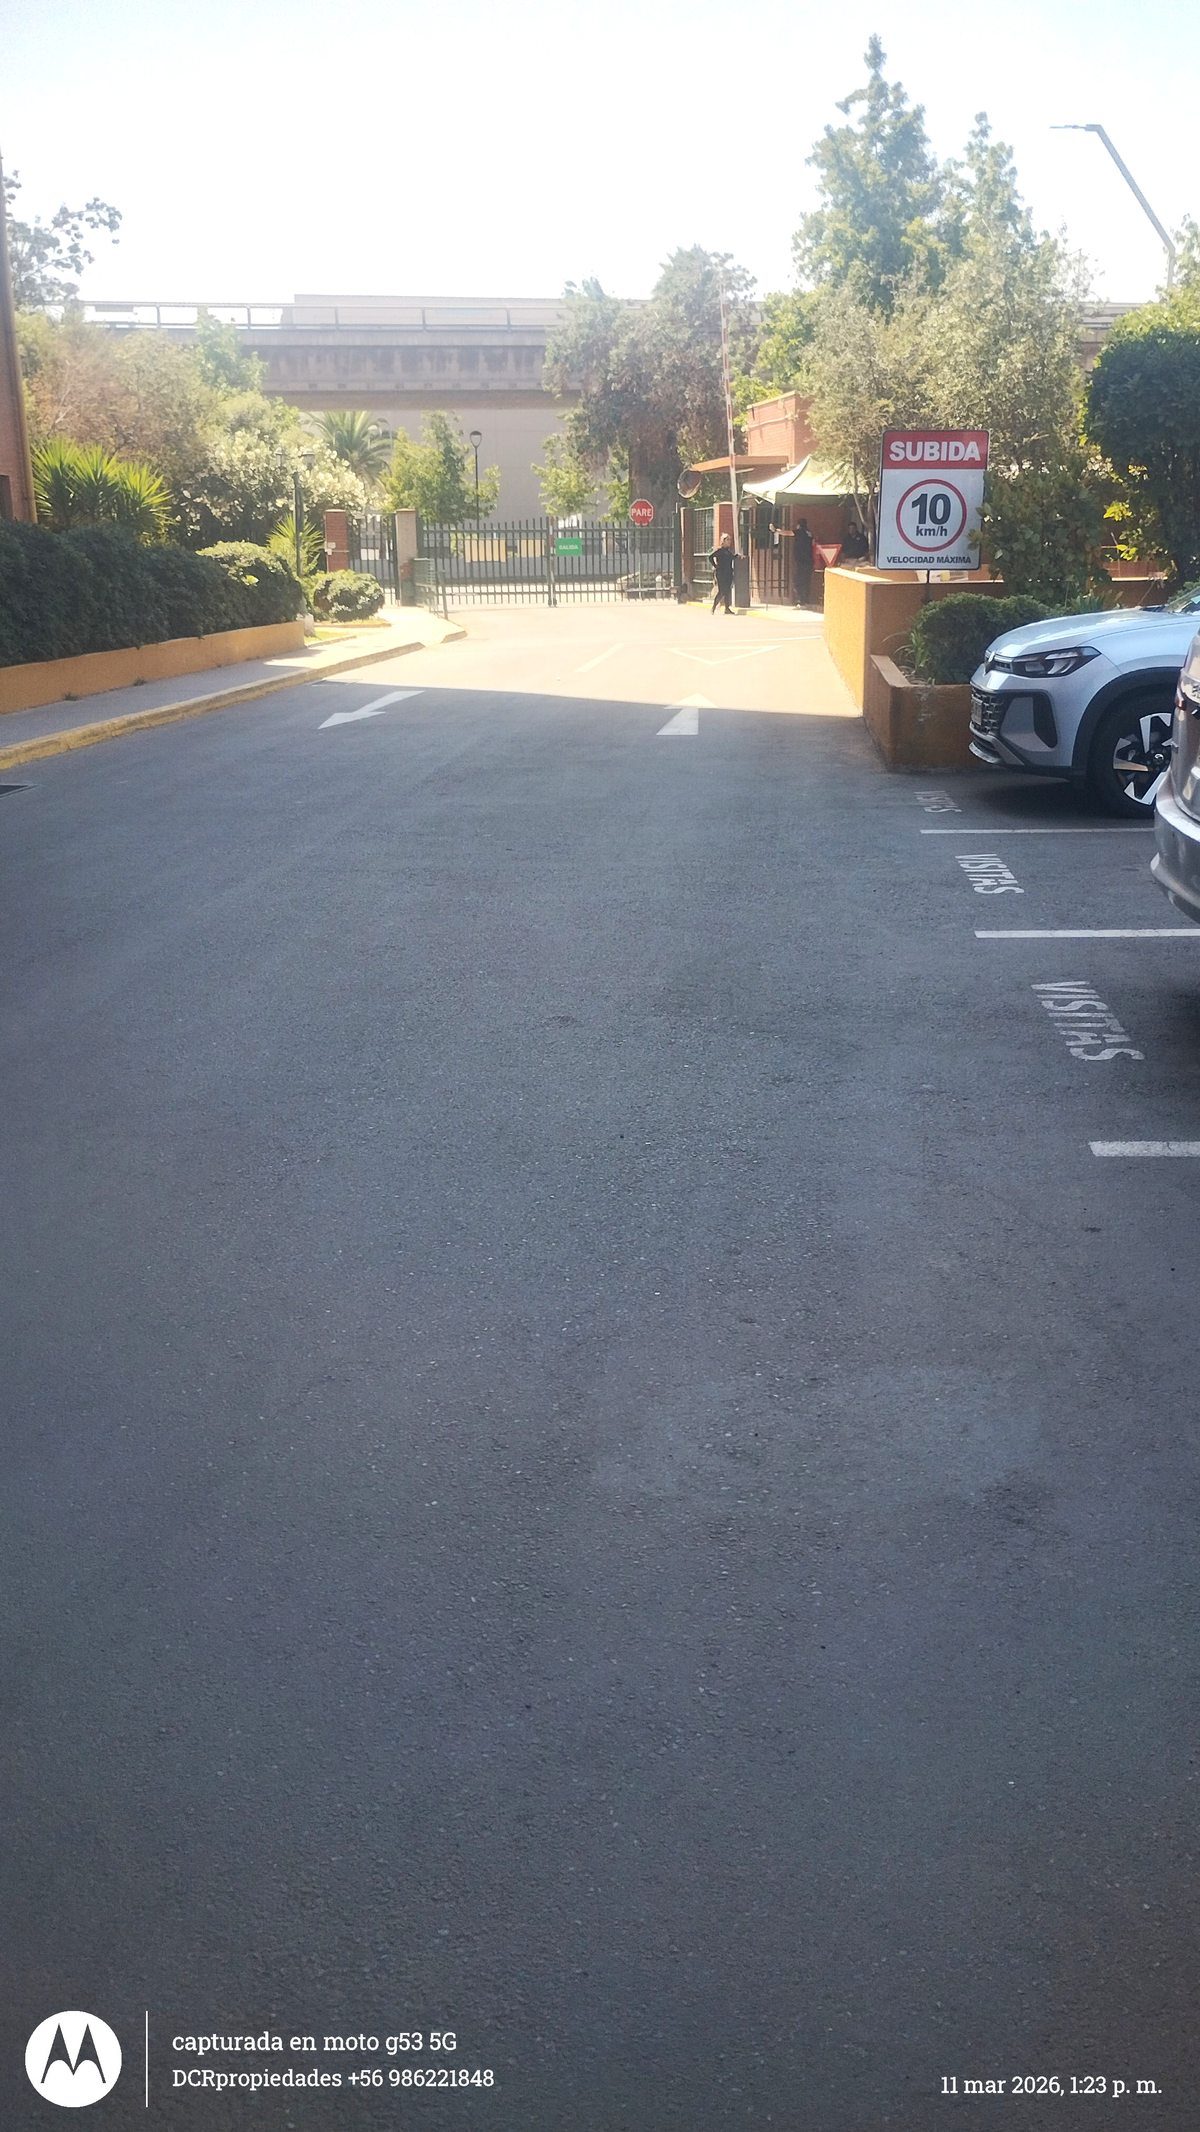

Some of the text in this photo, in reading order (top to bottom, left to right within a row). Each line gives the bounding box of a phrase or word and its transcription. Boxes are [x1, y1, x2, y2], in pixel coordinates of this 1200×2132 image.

[890, 441, 981, 462] SUBIDA
[631, 508, 652, 517] PARE
[911, 493, 951, 525] 10
[916, 526, 948, 537] km/h
[886, 554, 972, 564] VELOCIDAD MÁXIMA
[954, 853, 1025, 894] VISITAS
[1030, 980, 1146, 1062] VISITAS
